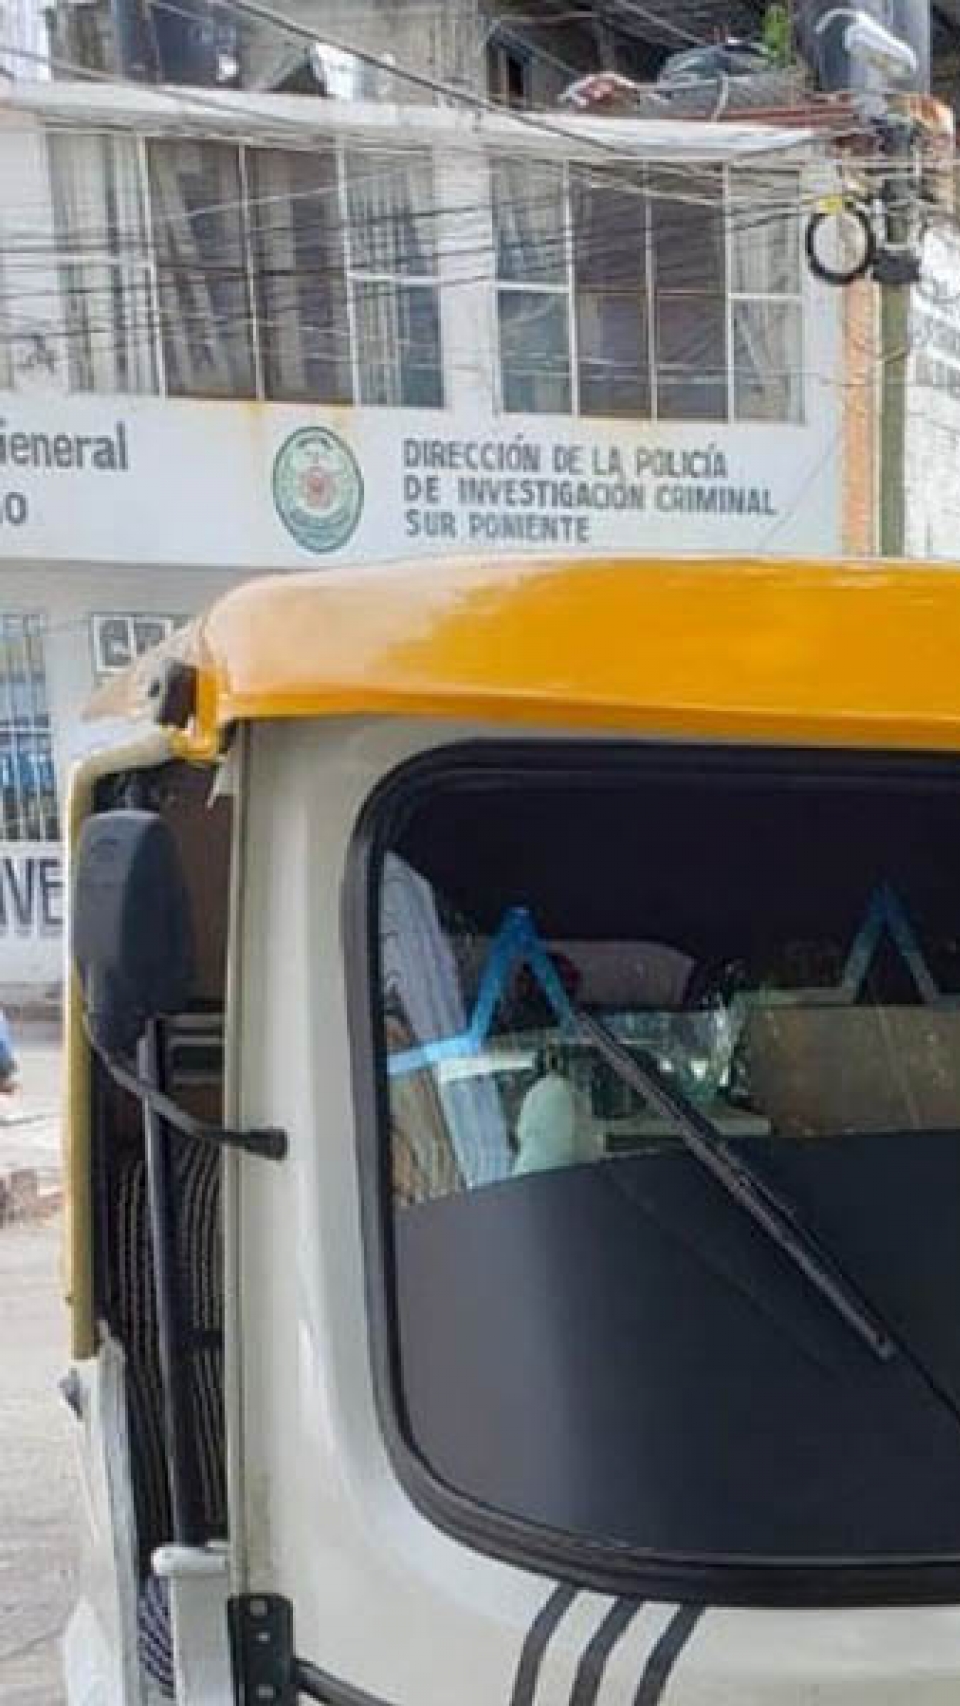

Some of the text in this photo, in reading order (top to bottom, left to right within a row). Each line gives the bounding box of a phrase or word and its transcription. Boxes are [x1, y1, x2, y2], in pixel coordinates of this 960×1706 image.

[403, 433, 728, 478] DIRECCIÓN DE LA POLICÍA
[403, 475, 440, 503] DE
[657, 485, 777, 516] CRIMINAL
[405, 509, 590, 543] SUR PONIENTE
